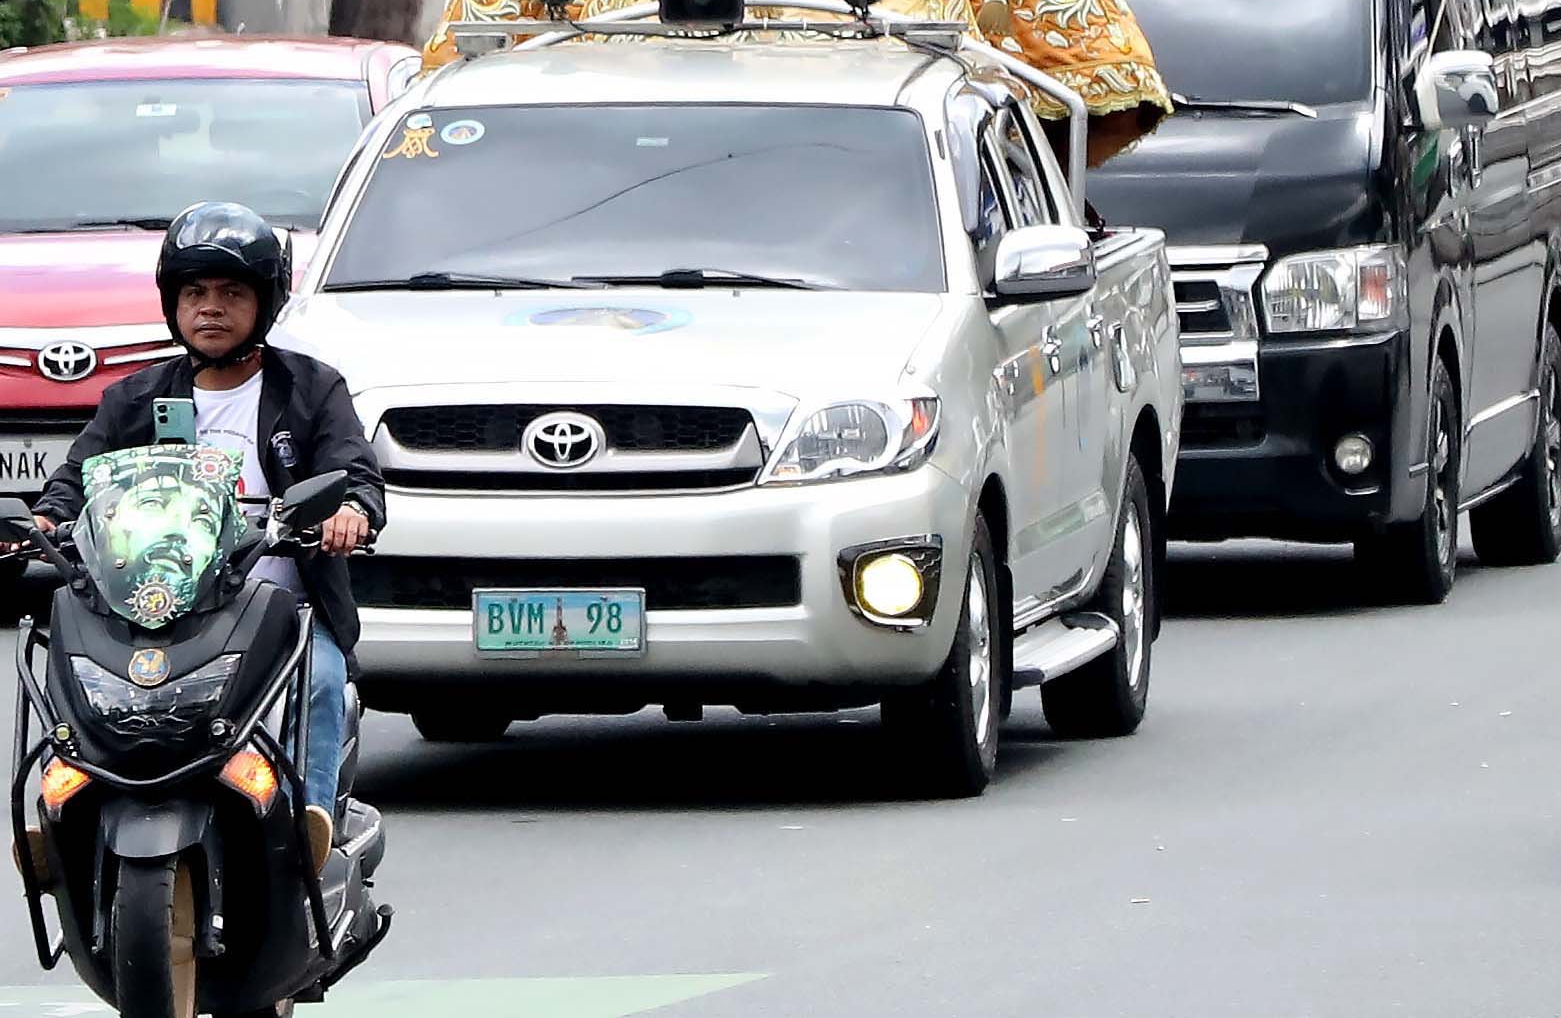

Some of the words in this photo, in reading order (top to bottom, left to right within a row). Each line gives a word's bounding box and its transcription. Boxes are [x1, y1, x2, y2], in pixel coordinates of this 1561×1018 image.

[0, 452, 48, 479] NAK
[487, 602, 545, 634] BVM
[586, 602, 623, 634] 98
